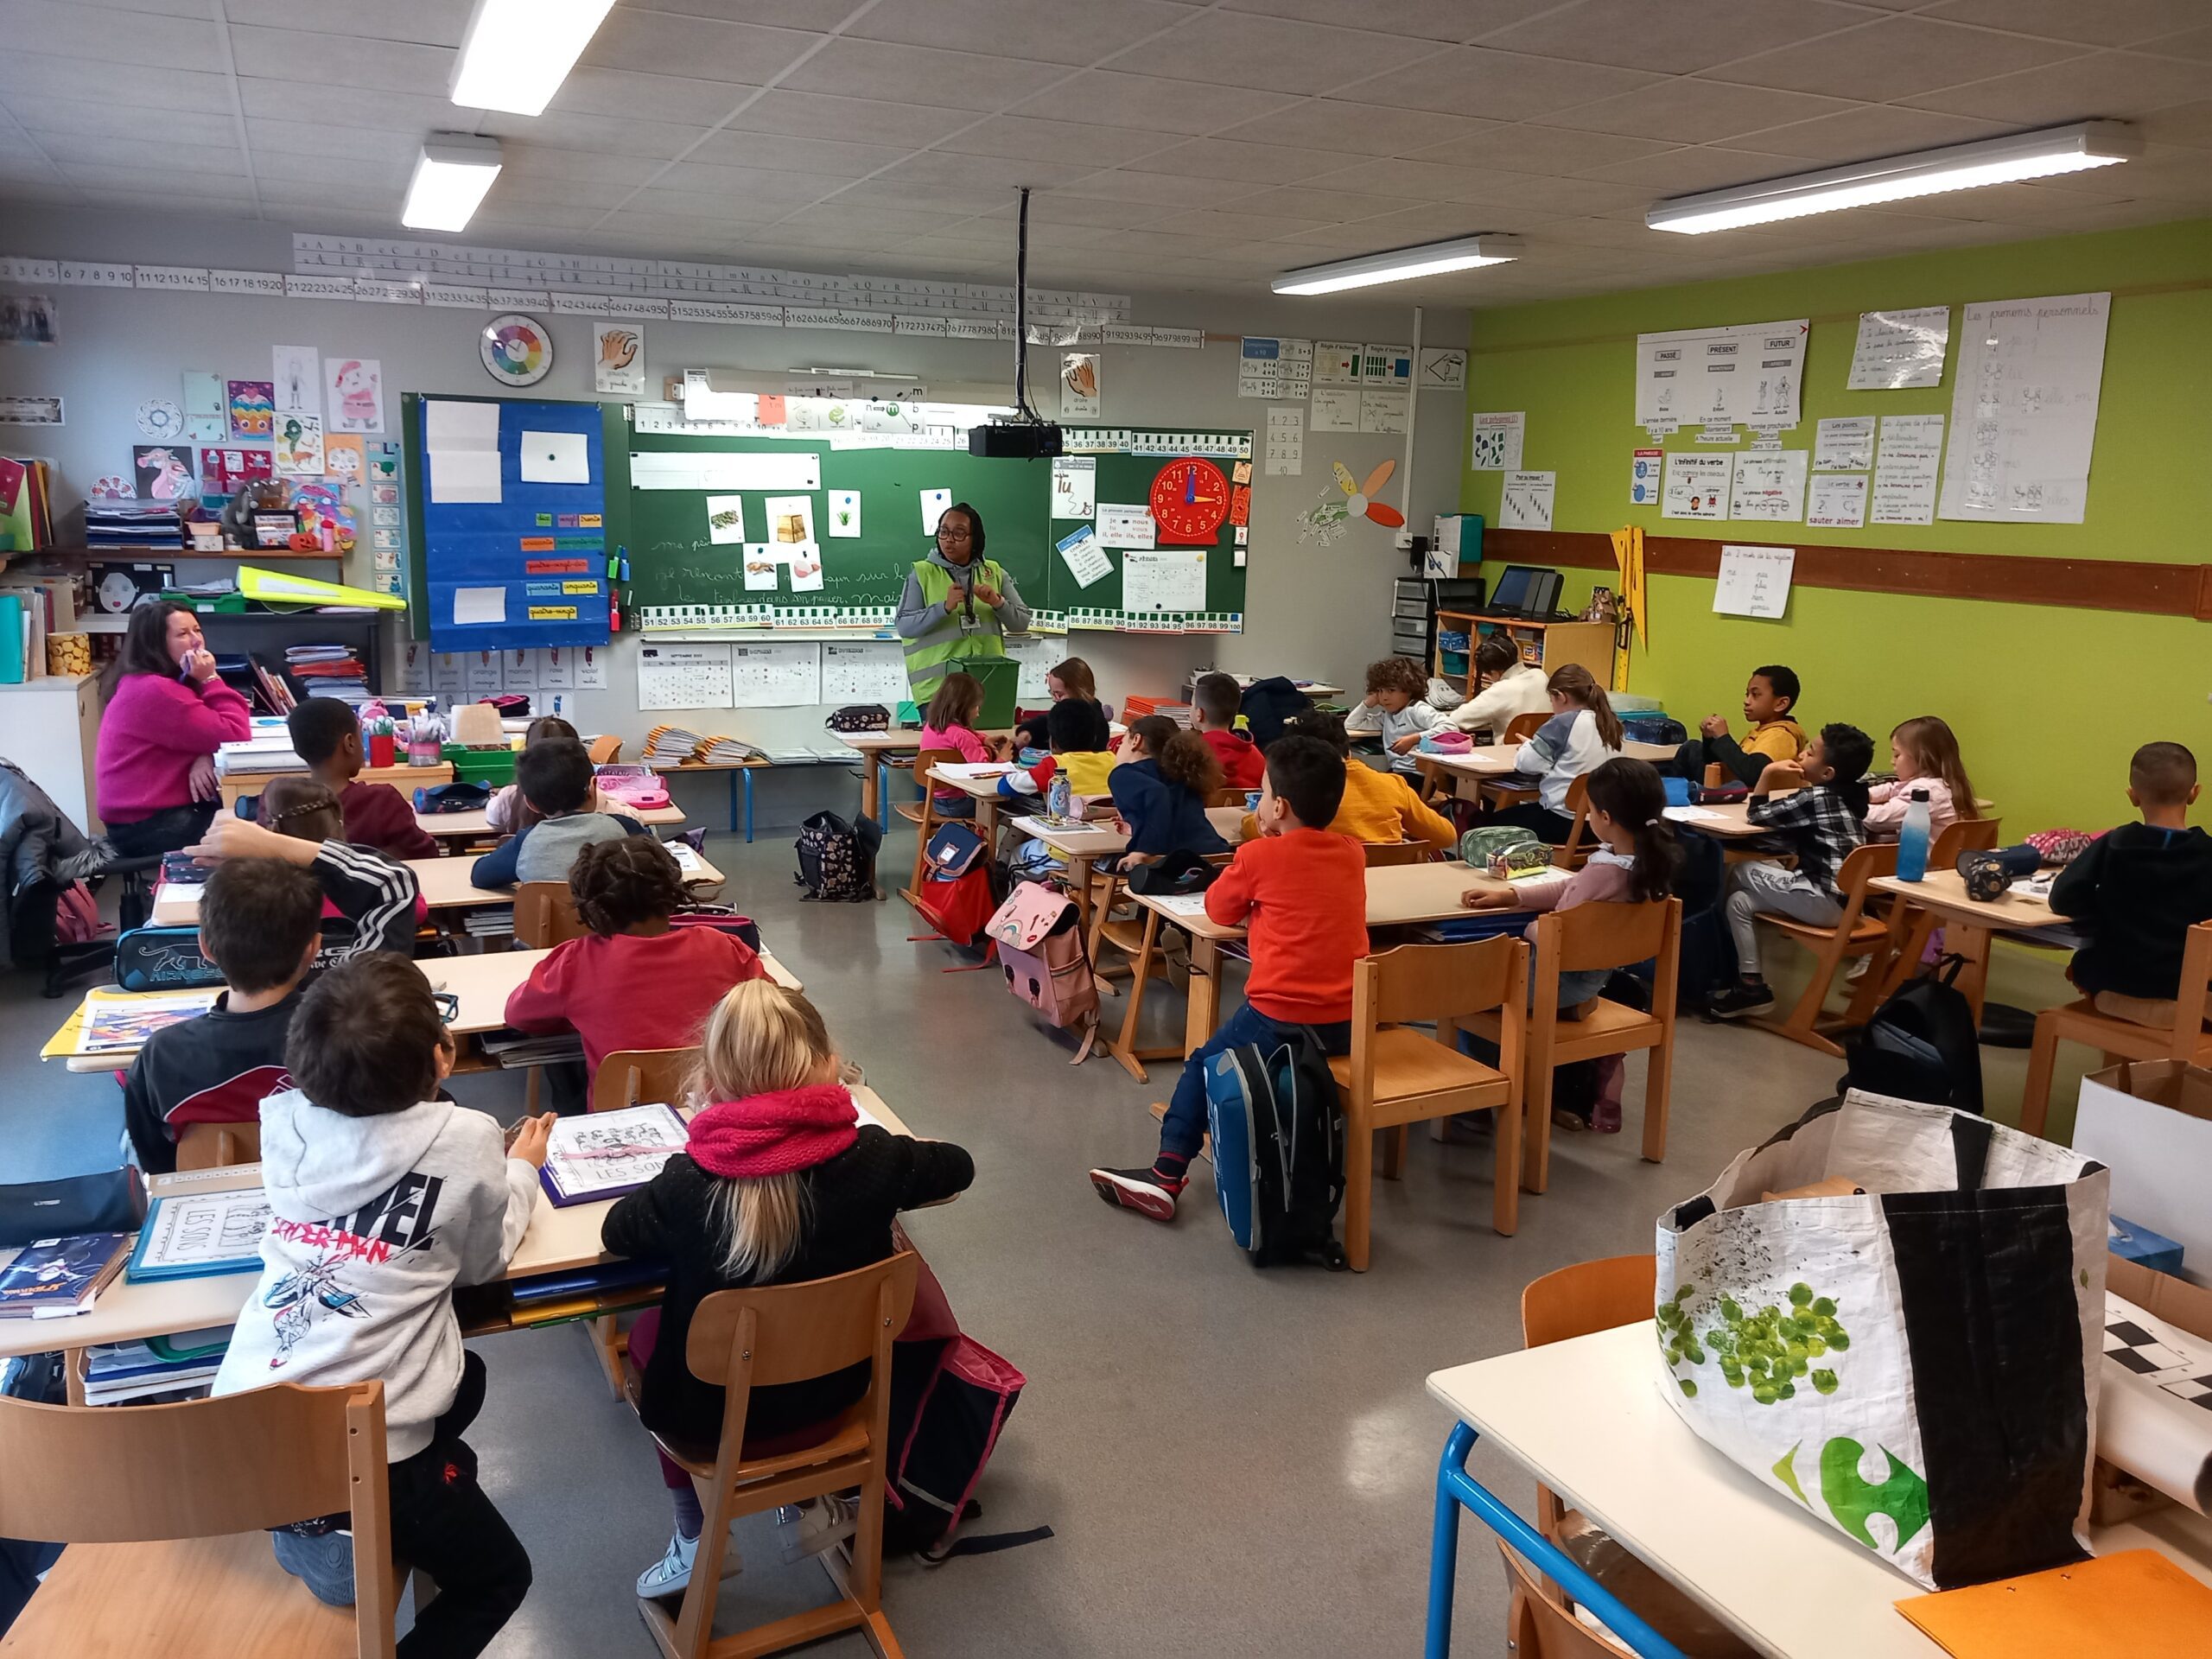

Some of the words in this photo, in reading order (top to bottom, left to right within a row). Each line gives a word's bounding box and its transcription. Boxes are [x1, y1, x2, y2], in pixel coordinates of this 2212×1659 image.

[65, 269, 71, 277] 6
[79, 270, 86, 279] 7
[94, 270, 100, 280] 8
[108, 271, 114, 280] 9
[121, 272, 131, 281] 10
[141, 273, 150, 282] 11
[155, 274, 165, 283] 12
[169, 275, 179, 283] 13
[183, 276, 194, 284] 14
[197, 276, 208, 285] 15
[1967, 307, 1981, 321] Les
[1990, 308, 2031, 328] pronoms
[2037, 307, 2098, 331] personnels
[1710, 345, 1736, 353] PRÉSENT
[1272, 416, 1274, 425] 1
[1282, 416, 1287, 425] 2
[1294, 416, 1298, 426] 3
[1271, 433, 1274, 442] 4
[1282, 433, 1286, 442] 5
[1294, 433, 1298, 442] 6
[1271, 449, 1274, 458] 7
[1281, 449, 1286, 459] 8
[1293, 450, 1298, 459] 9
[1172, 470, 1181, 480] 11
[1186, 466, 1197, 475] 12
[1280, 467, 1287, 475] 10
[1204, 471, 1208, 480] 1
[1162, 481, 1173, 490] 10
[1158, 494, 1163, 503] 9
[1217, 496, 1223, 505] 3
[1162, 509, 1167, 518] 8
[1211, 511, 1217, 519] 4
[1173, 520, 1179, 529] 7
[1185, 524, 1192, 532] 6
[1200, 520, 1205, 530] 5
[856, 571, 889, 582] sur
[595, 1168, 627, 1179] LES
[635, 1160, 666, 1173] SON
[185, 1210, 216, 1224] LES
[177, 1227, 212, 1250] SONS
